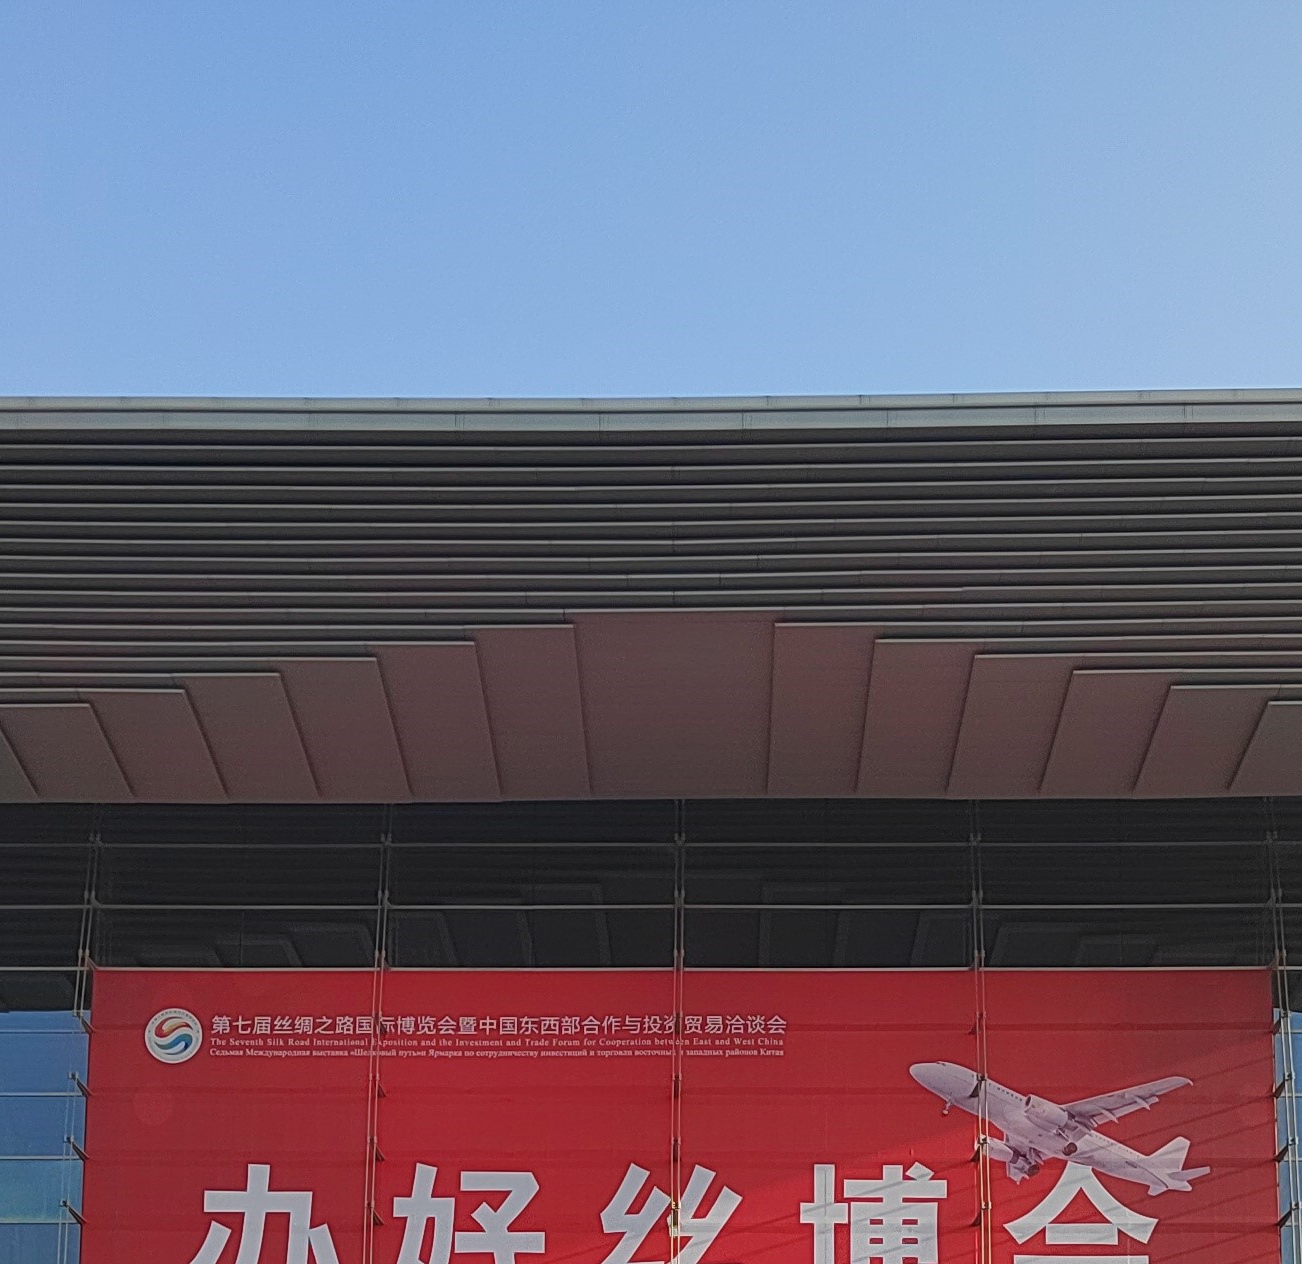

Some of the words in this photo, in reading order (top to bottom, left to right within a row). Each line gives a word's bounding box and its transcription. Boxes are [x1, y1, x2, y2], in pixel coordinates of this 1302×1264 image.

[210, 1014, 787, 1035] 第七届丝绸之路国际博览会暨中国东西部合作与投资贸易洽谈会
[210, 1038, 226, 1046] The
[229, 1038, 264, 1046] Seventh
[267, 1038, 284, 1046] Silk
[288, 1038, 310, 1046] Road
[313, 1038, 368, 1046] International
[420, 1038, 436, 1046] and
[439, 1038, 453, 1046] the
[455, 1038, 503, 1046] Investment
[505, 1038, 522, 1046] and
[525, 1038, 549, 1046] Trade
[552, 1038, 580, 1046] Forum
[583, 1038, 596, 1046] for
[599, 1038, 652, 1048] Cooperation
[654, 1037, 690, 1046] between
[693, 1037, 712, 1046] East
[715, 1037, 730, 1046] and
[734, 1037, 755, 1046] West
[757, 1037, 784, 1046] China
